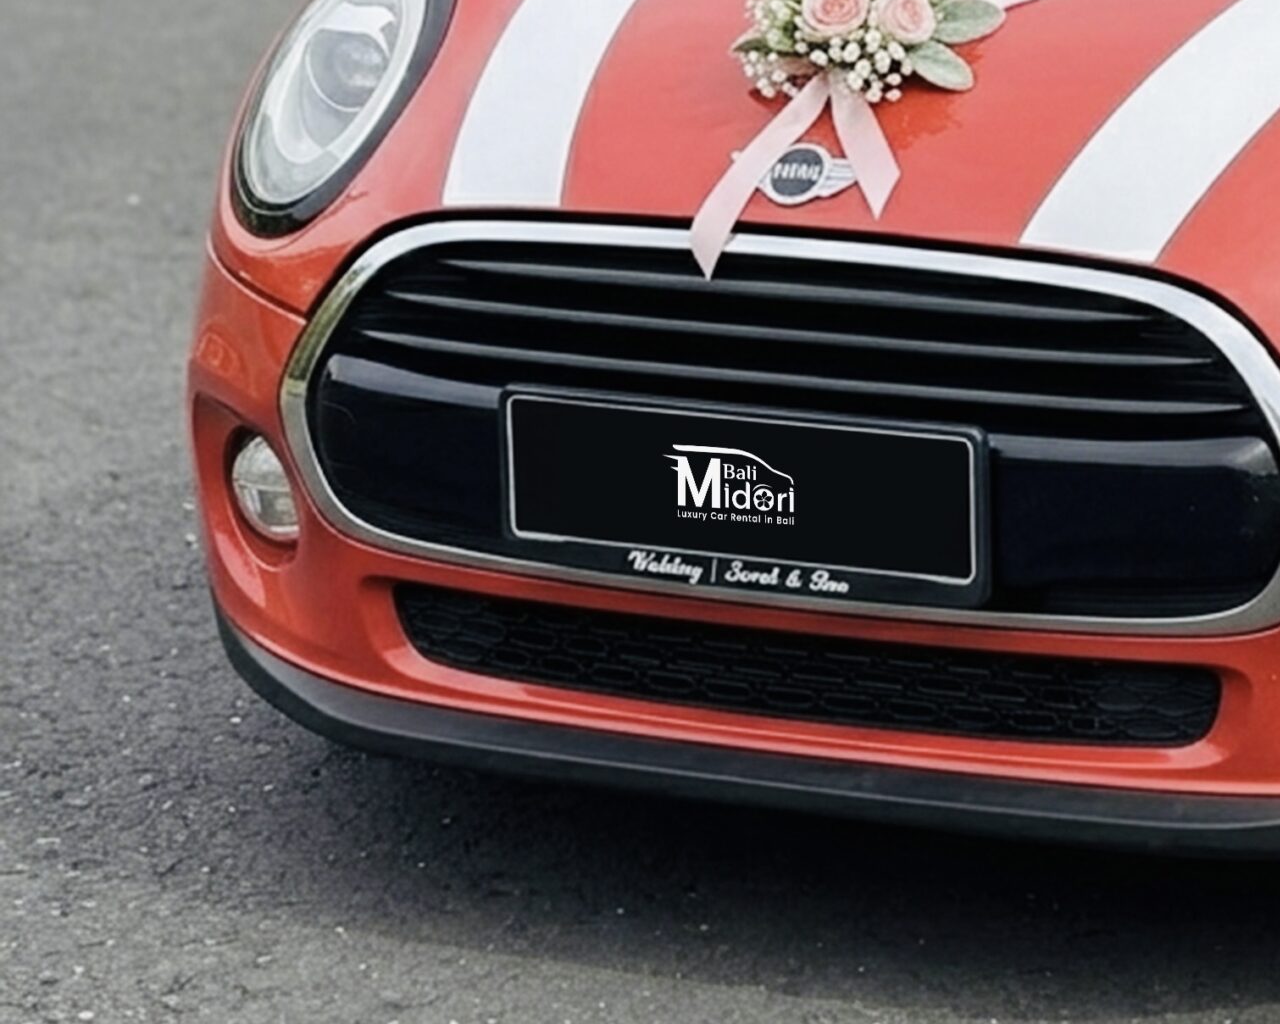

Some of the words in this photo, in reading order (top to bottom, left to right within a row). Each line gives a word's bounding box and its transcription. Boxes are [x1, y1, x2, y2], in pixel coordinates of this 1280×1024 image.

[722, 463, 757, 481] Bali
[676, 455, 795, 513] Midori
[677, 509, 708, 522] Luxury
[710, 511, 728, 521] Car
[730, 513, 761, 524] Rental
[776, 516, 795, 526] Bali
